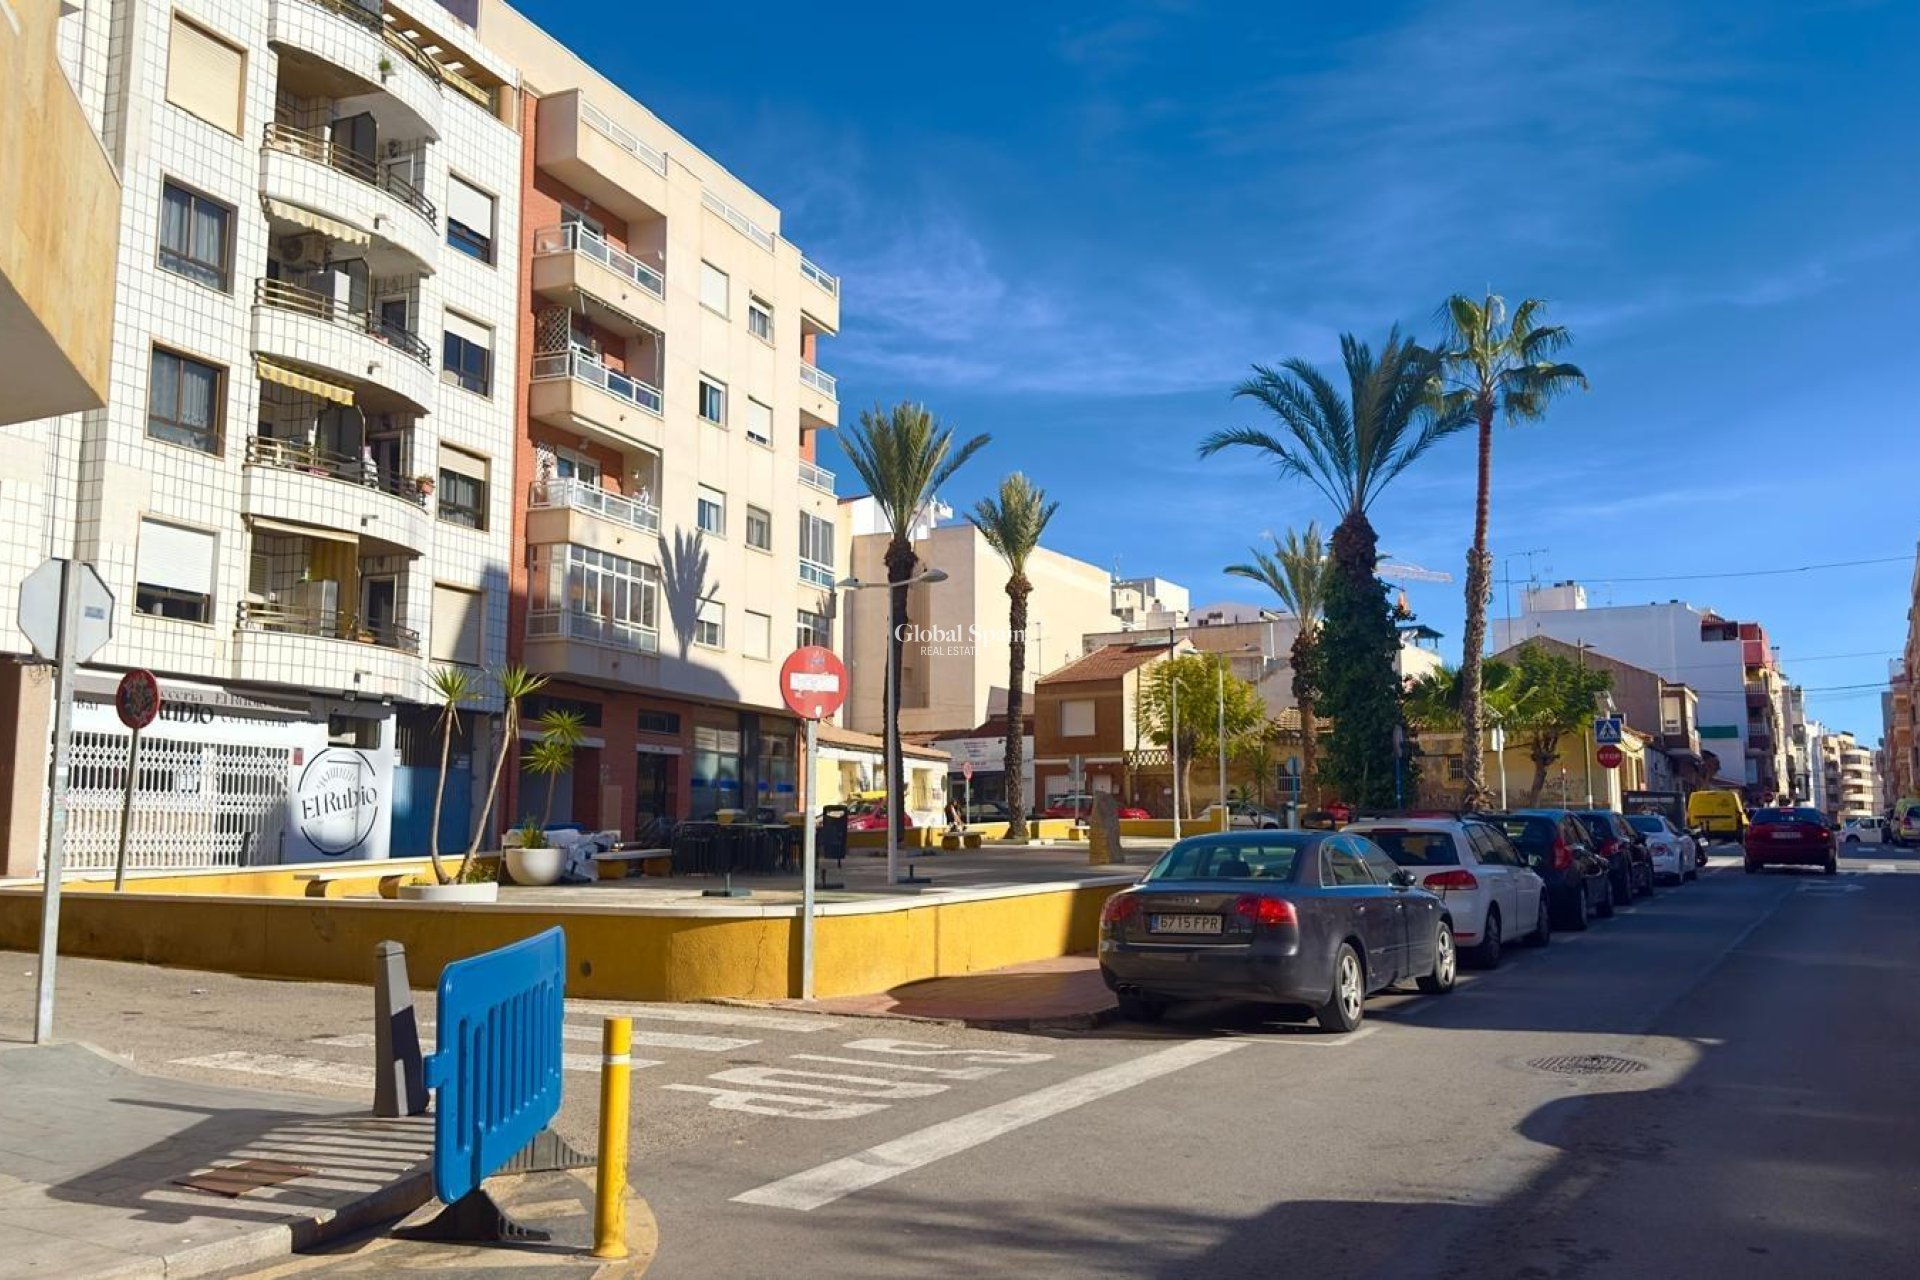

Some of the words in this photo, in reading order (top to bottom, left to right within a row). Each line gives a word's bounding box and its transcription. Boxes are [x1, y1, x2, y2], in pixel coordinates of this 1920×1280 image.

[302, 795, 320, 820] El
[324, 785, 377, 814] Rubio
[1161, 914, 1191, 929] 6715
[1194, 916, 1218, 929] FPR
[661, 1037, 1056, 1120] STOP
